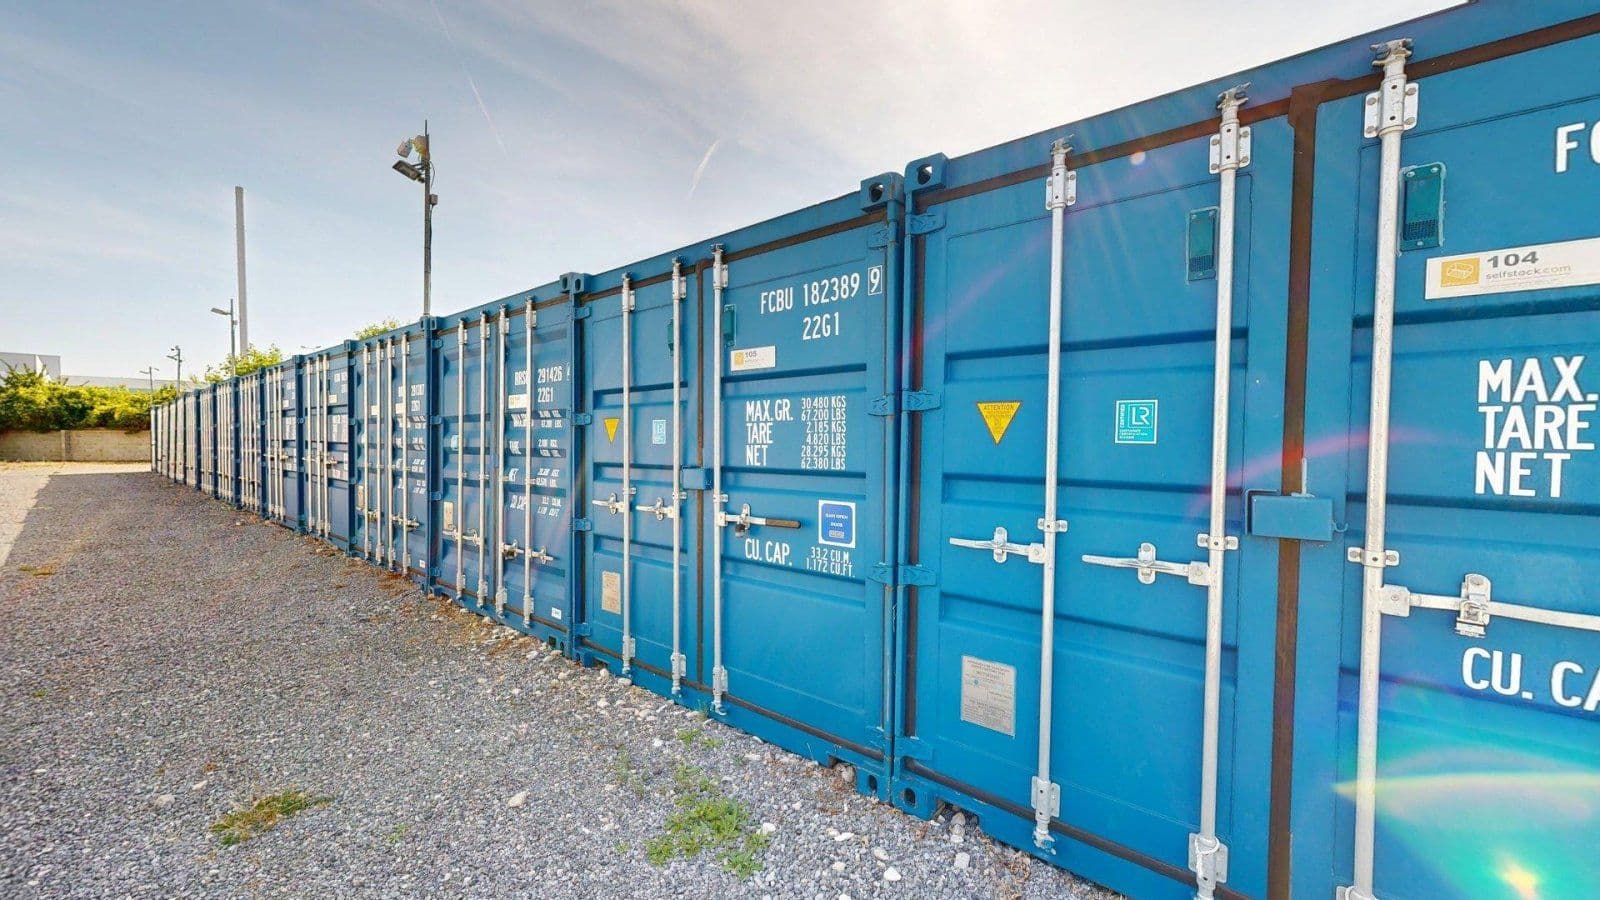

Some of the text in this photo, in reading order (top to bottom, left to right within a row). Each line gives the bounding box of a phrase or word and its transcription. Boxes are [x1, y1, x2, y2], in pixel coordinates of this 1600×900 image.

[1487, 252, 1539, 268] 104
[760, 268, 880, 314] FCBU 182389 9
[802, 312, 840, 340] 22G1
[1478, 356, 1600, 403] MAX.
[831, 396, 846, 408] KGS
[831, 410, 846, 421] LBS
[1132, 407, 1150, 425] LR
[746, 422, 773, 444] TARE
[831, 422, 846, 433] KGS
[1478, 404, 1596, 450] TARE
[831, 434, 846, 445] LBS
[746, 445, 768, 466] NET
[831, 446, 846, 457] KGS
[831, 457, 846, 469] LBS
[1475, 452, 1571, 498] NET
[745, 538, 792, 566] CU. CAP.
[811, 547, 828, 560] 33.2
[1462, 647, 1533, 700] CU.
